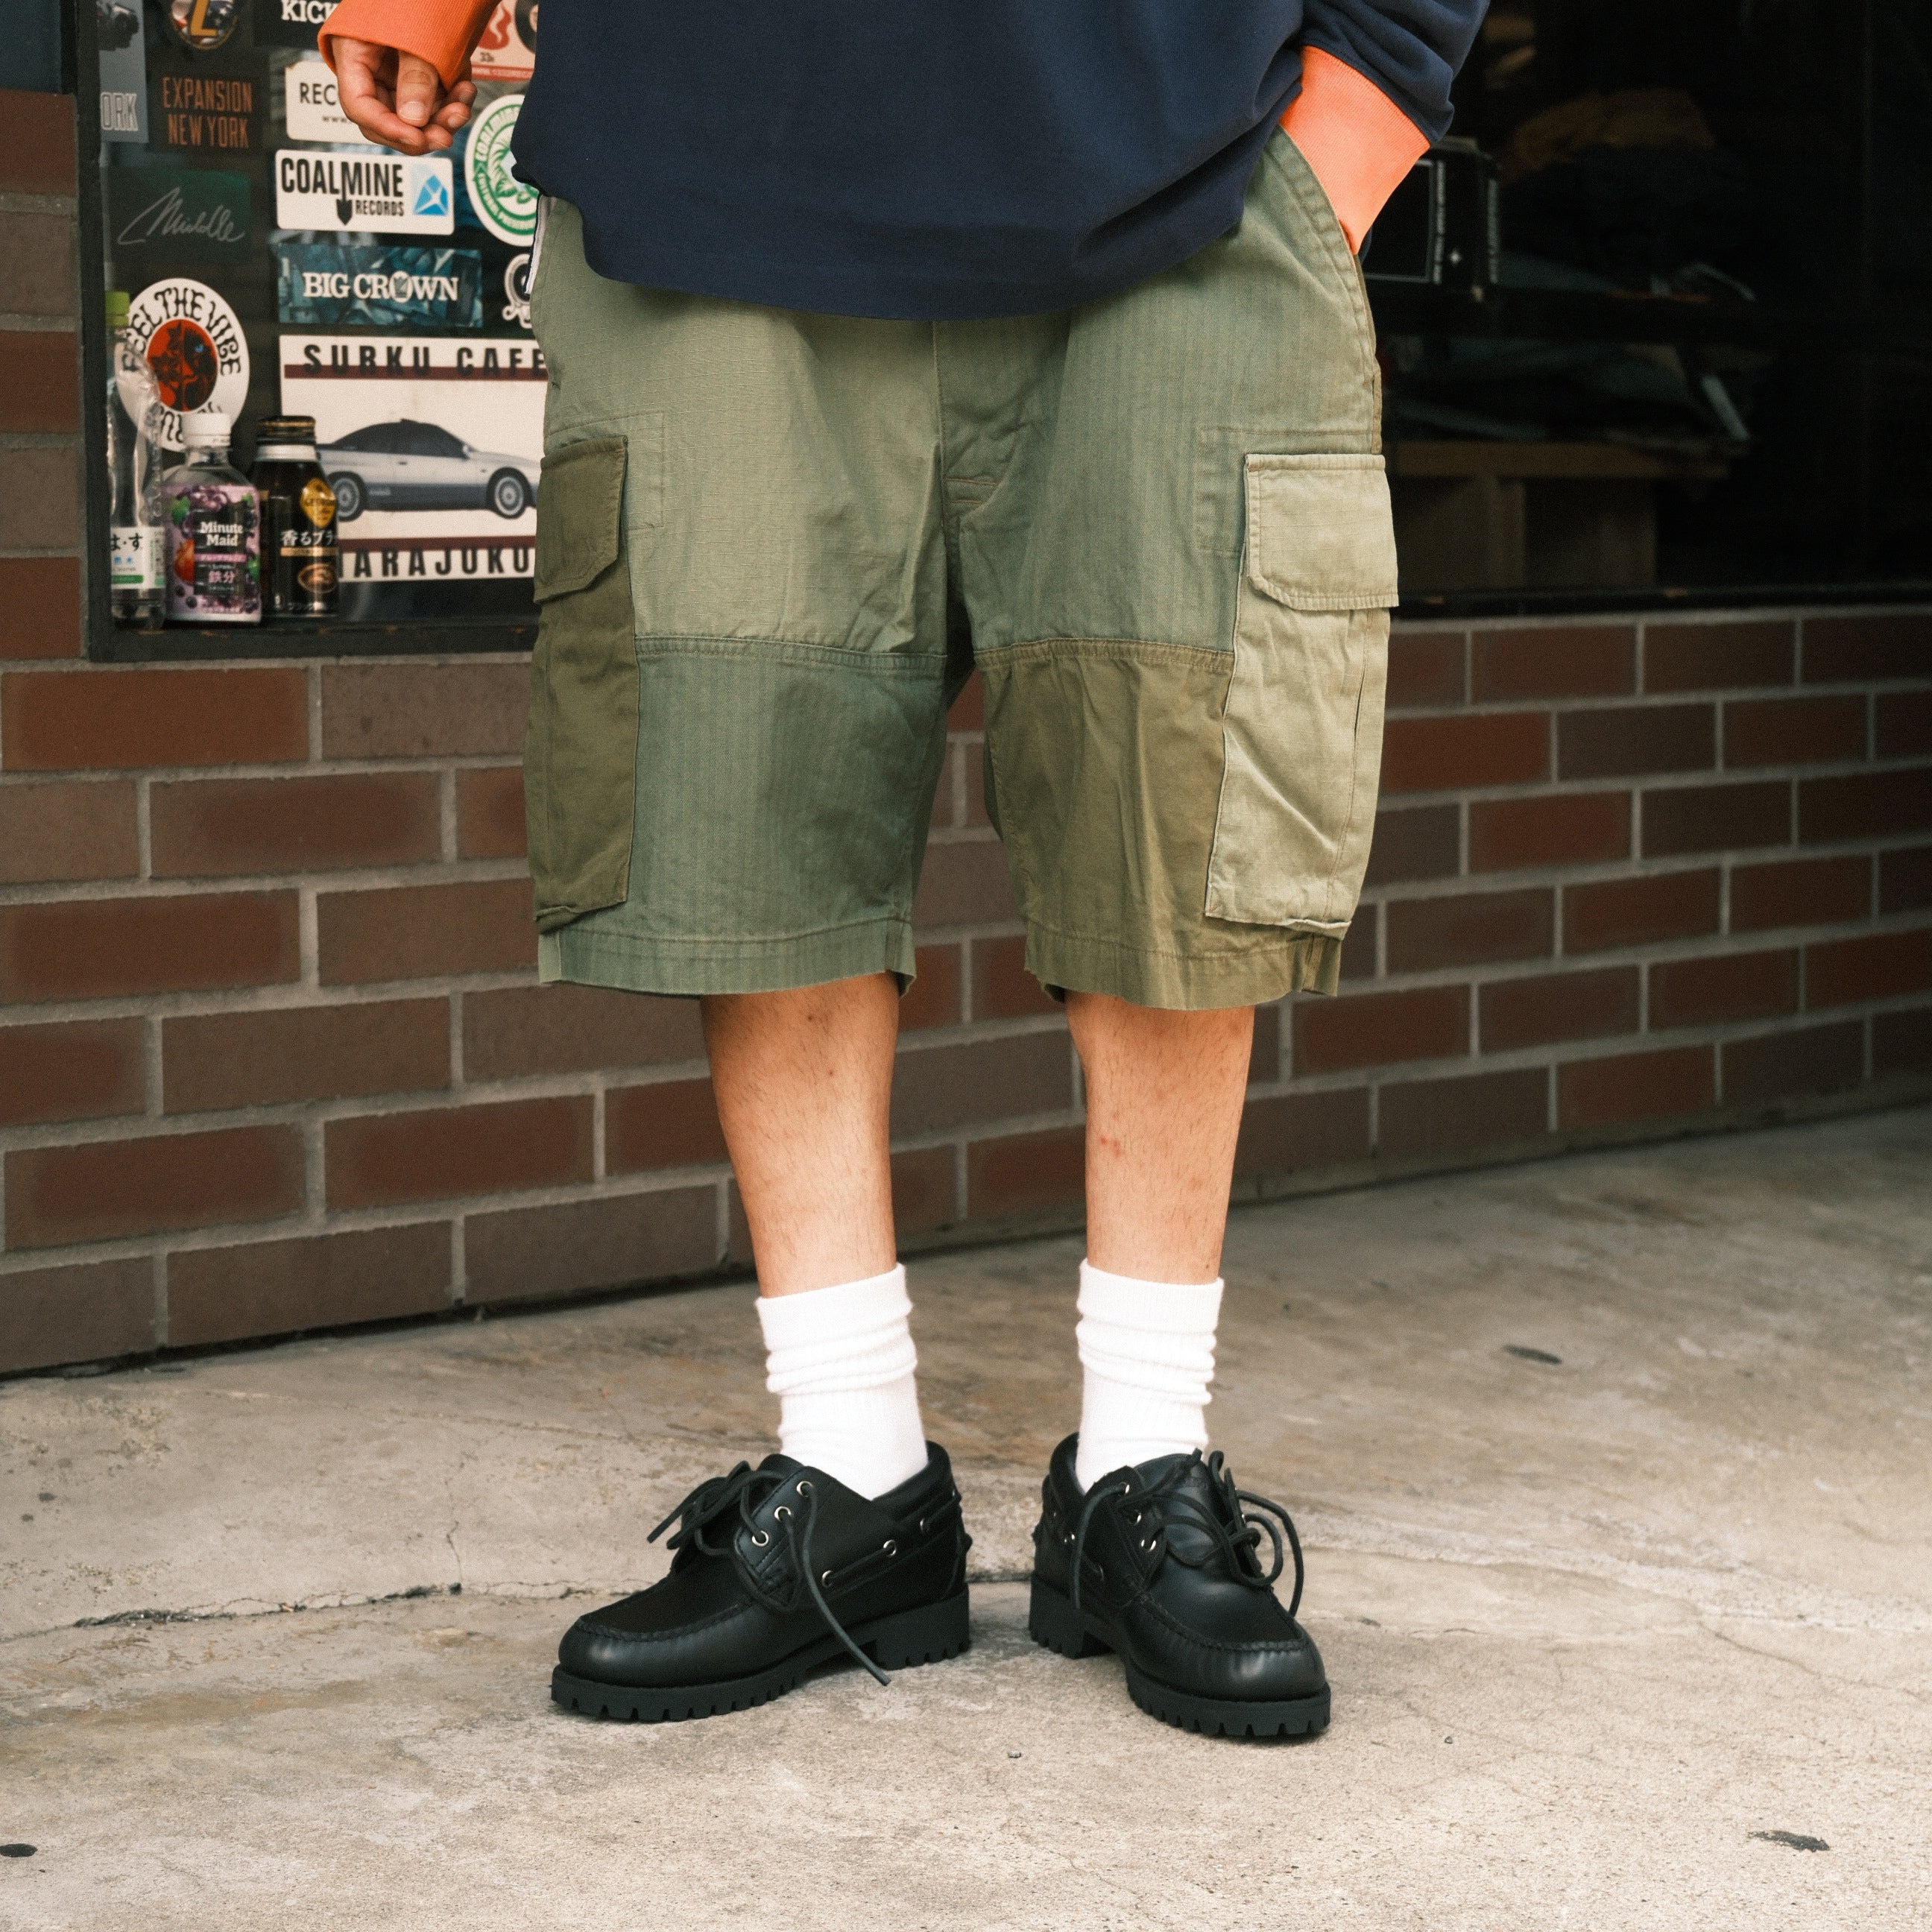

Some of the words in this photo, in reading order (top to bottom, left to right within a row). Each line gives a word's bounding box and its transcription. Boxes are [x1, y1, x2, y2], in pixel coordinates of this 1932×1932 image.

[162, 77, 253, 113] EXPANSION
[300, 82, 338, 106] REC
[168, 113, 203, 146] NEW
[206, 116, 250, 148] YORK
[281, 157, 403, 198] COALMINE
[355, 200, 405, 217] RECORDS
[303, 272, 350, 298] BIG
[353, 271, 458, 303] CROWN
[154, 287, 205, 321] THE
[206, 300, 242, 376] VIBE
[456, 347, 549, 377] CAFE
[200, 521, 244, 534] Minute
[206, 534, 239, 546] Maid
